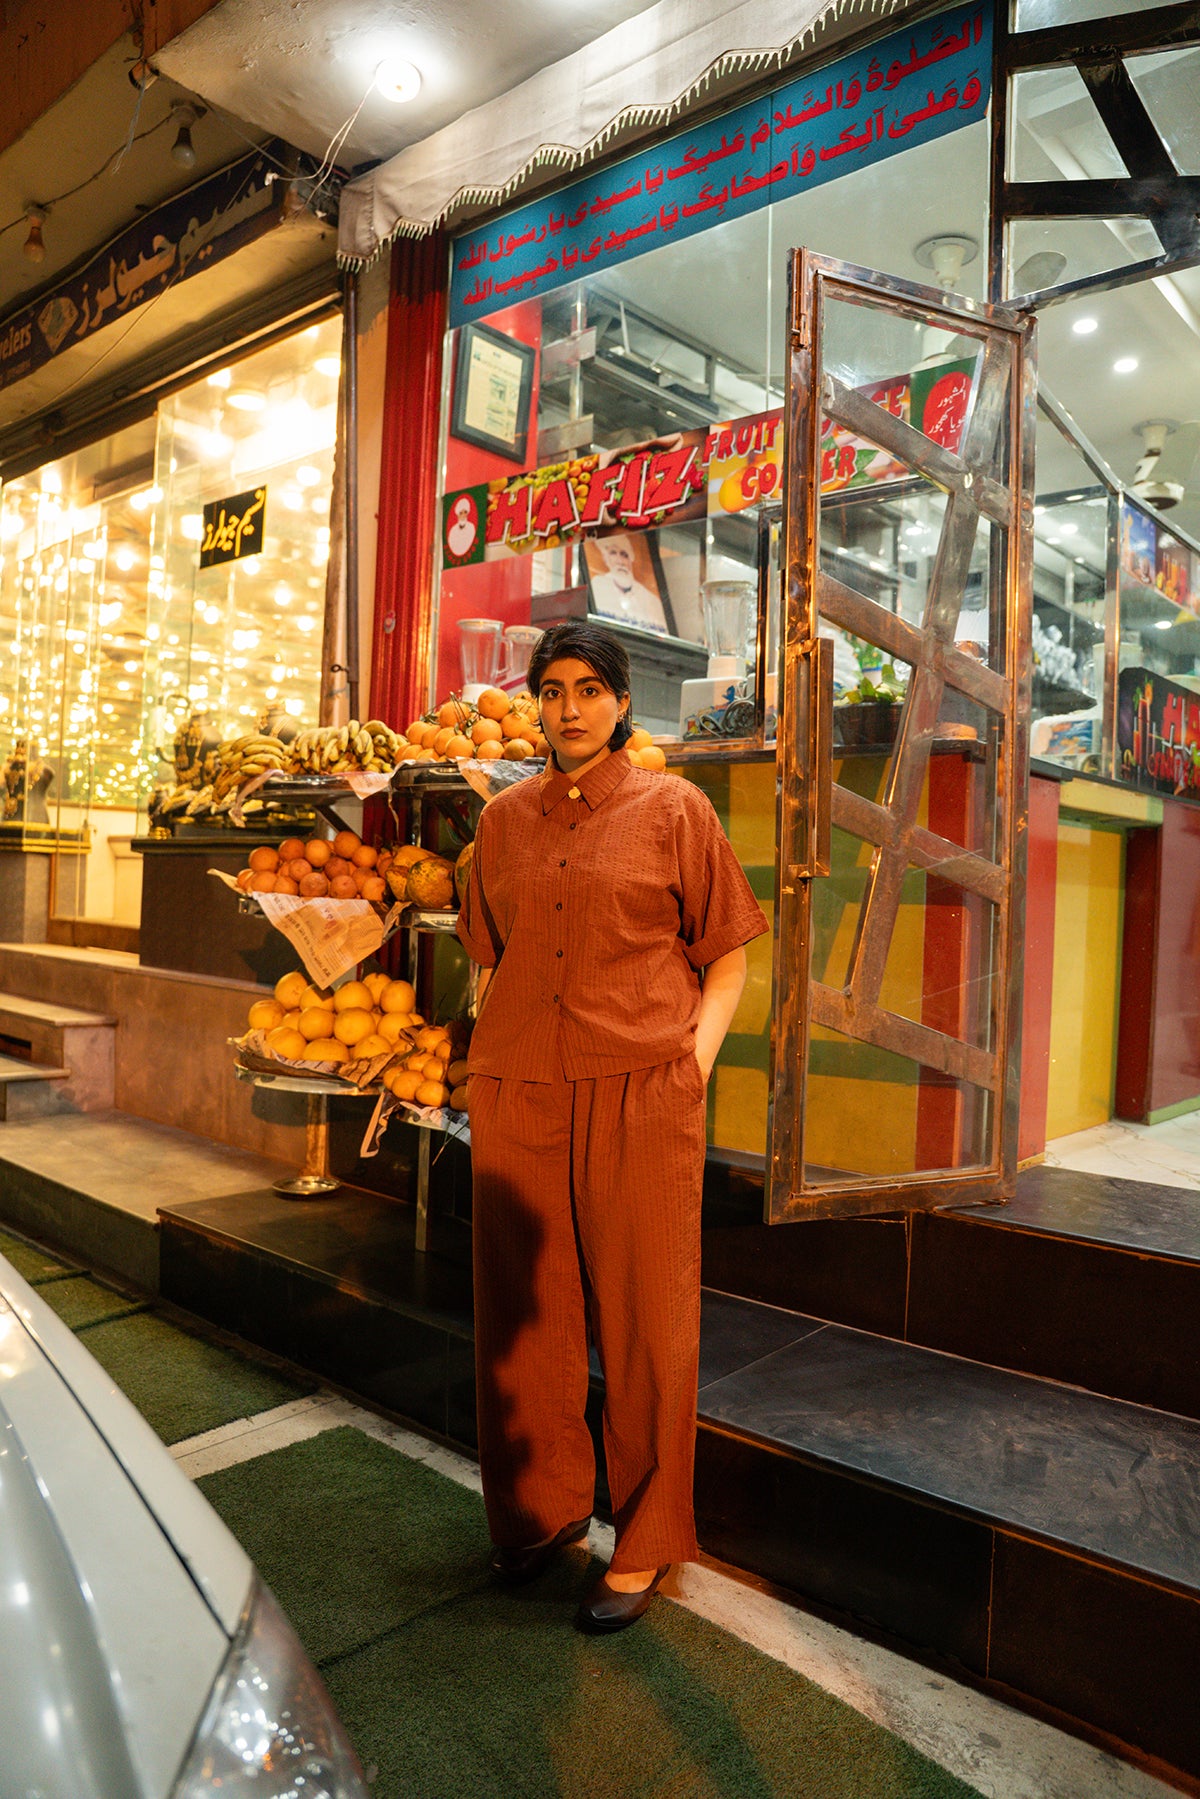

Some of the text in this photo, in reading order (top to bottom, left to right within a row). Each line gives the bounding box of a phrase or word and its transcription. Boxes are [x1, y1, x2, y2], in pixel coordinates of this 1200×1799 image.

[75, 234, 177, 336] جیولرز
[484, 416, 781, 547] HAFIZ FRUIT
[742, 445, 858, 500] COER
